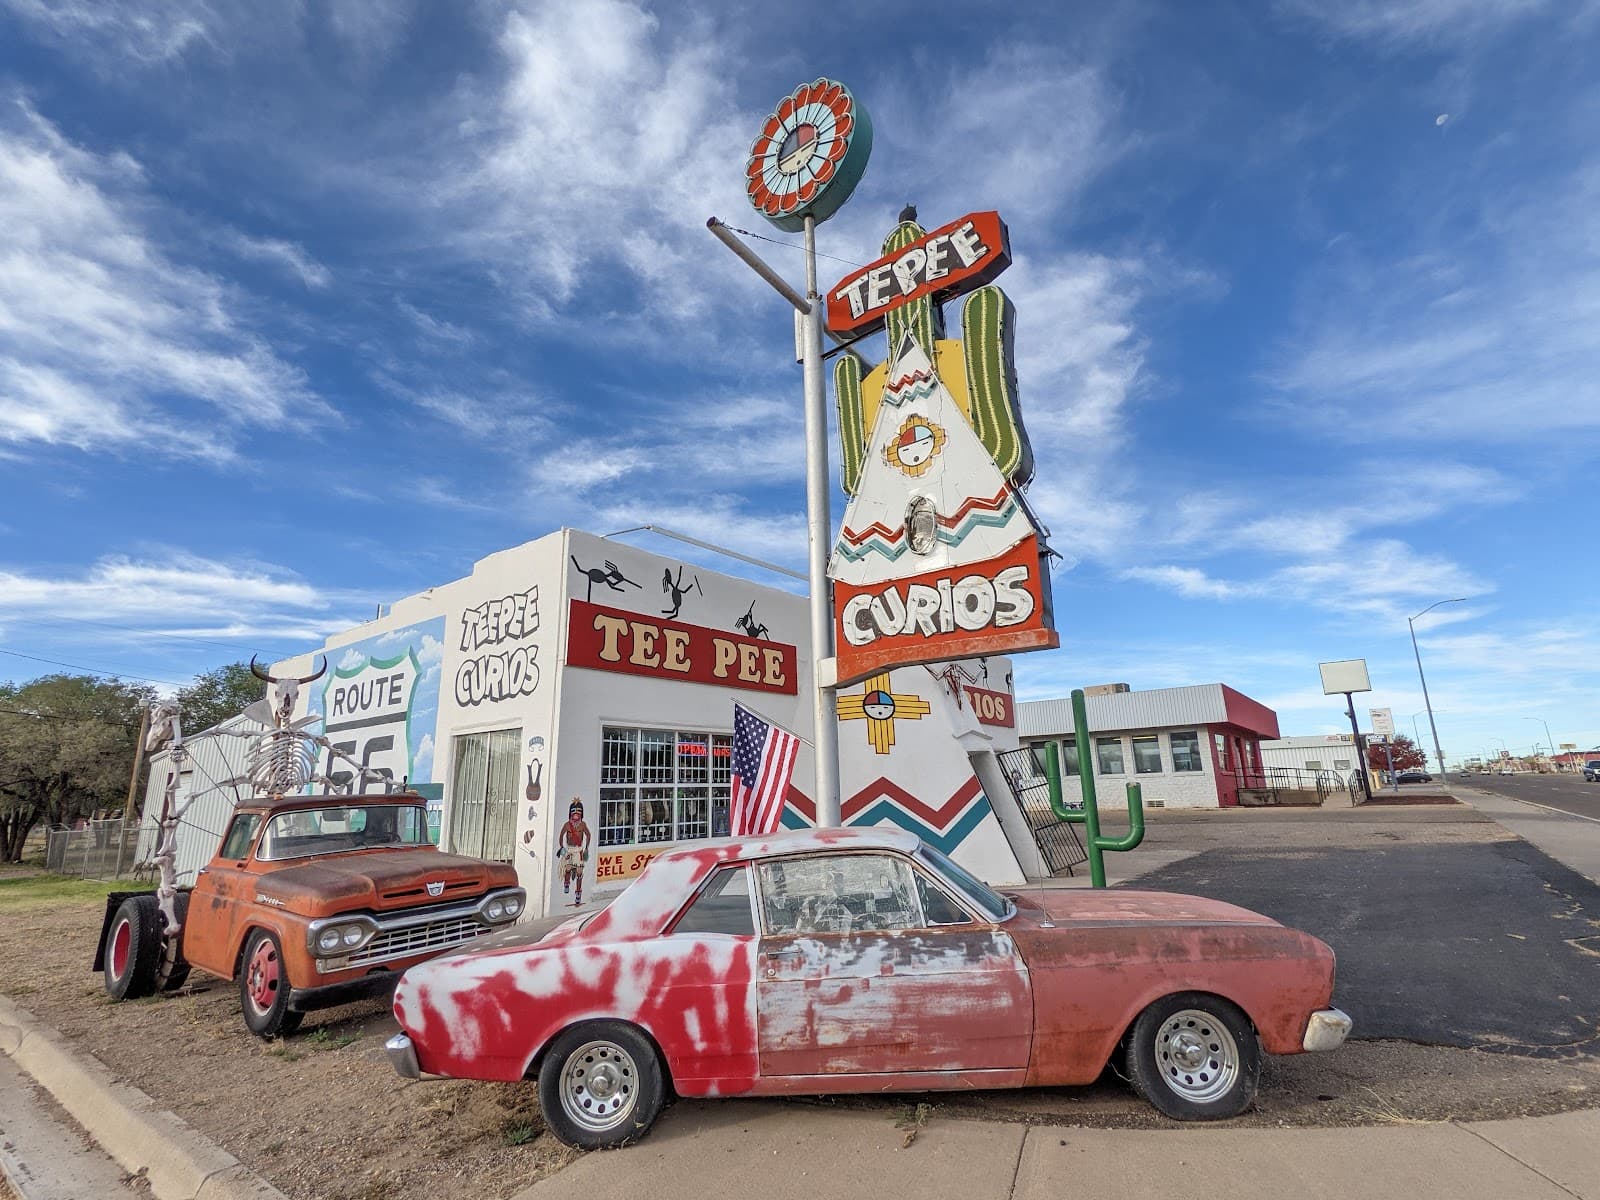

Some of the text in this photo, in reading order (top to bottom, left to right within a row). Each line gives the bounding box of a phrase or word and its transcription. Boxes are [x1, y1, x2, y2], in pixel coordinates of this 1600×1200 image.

[835, 220, 989, 320] TEPEE
[459, 584, 541, 652] TEEPEE
[841, 565, 1035, 647] CURIOS
[455, 644, 540, 708] CURIOS
[592, 613, 787, 688] TEE PEE
[333, 672, 405, 717] ROUTE
[323, 734, 395, 796] 66
[597, 864, 625, 877] SELL
[599, 855, 623, 866] WE
